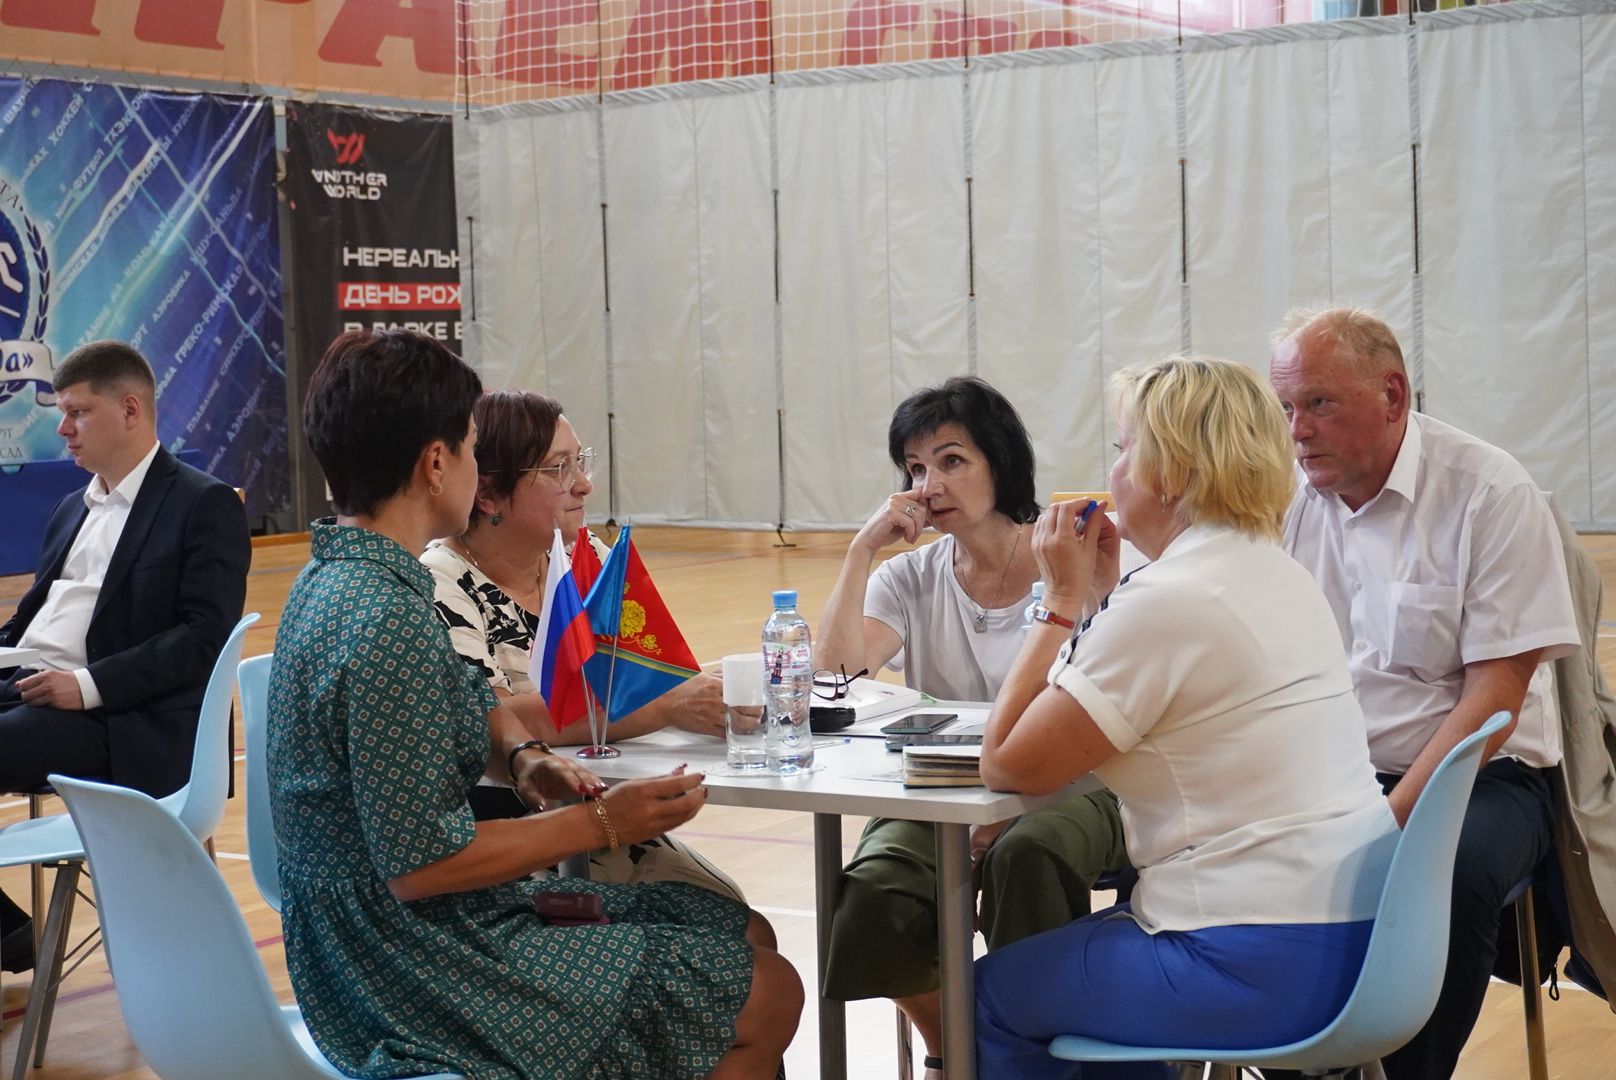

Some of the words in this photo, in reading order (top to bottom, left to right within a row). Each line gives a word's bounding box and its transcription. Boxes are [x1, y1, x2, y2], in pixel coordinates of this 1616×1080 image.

[48, 92, 84, 146] ХОККЕЙ
[323, 184, 381, 200] WORLD
[152, 269, 191, 322] АЭРОБИКА
[343, 284, 411, 308] ДЕНЬ
